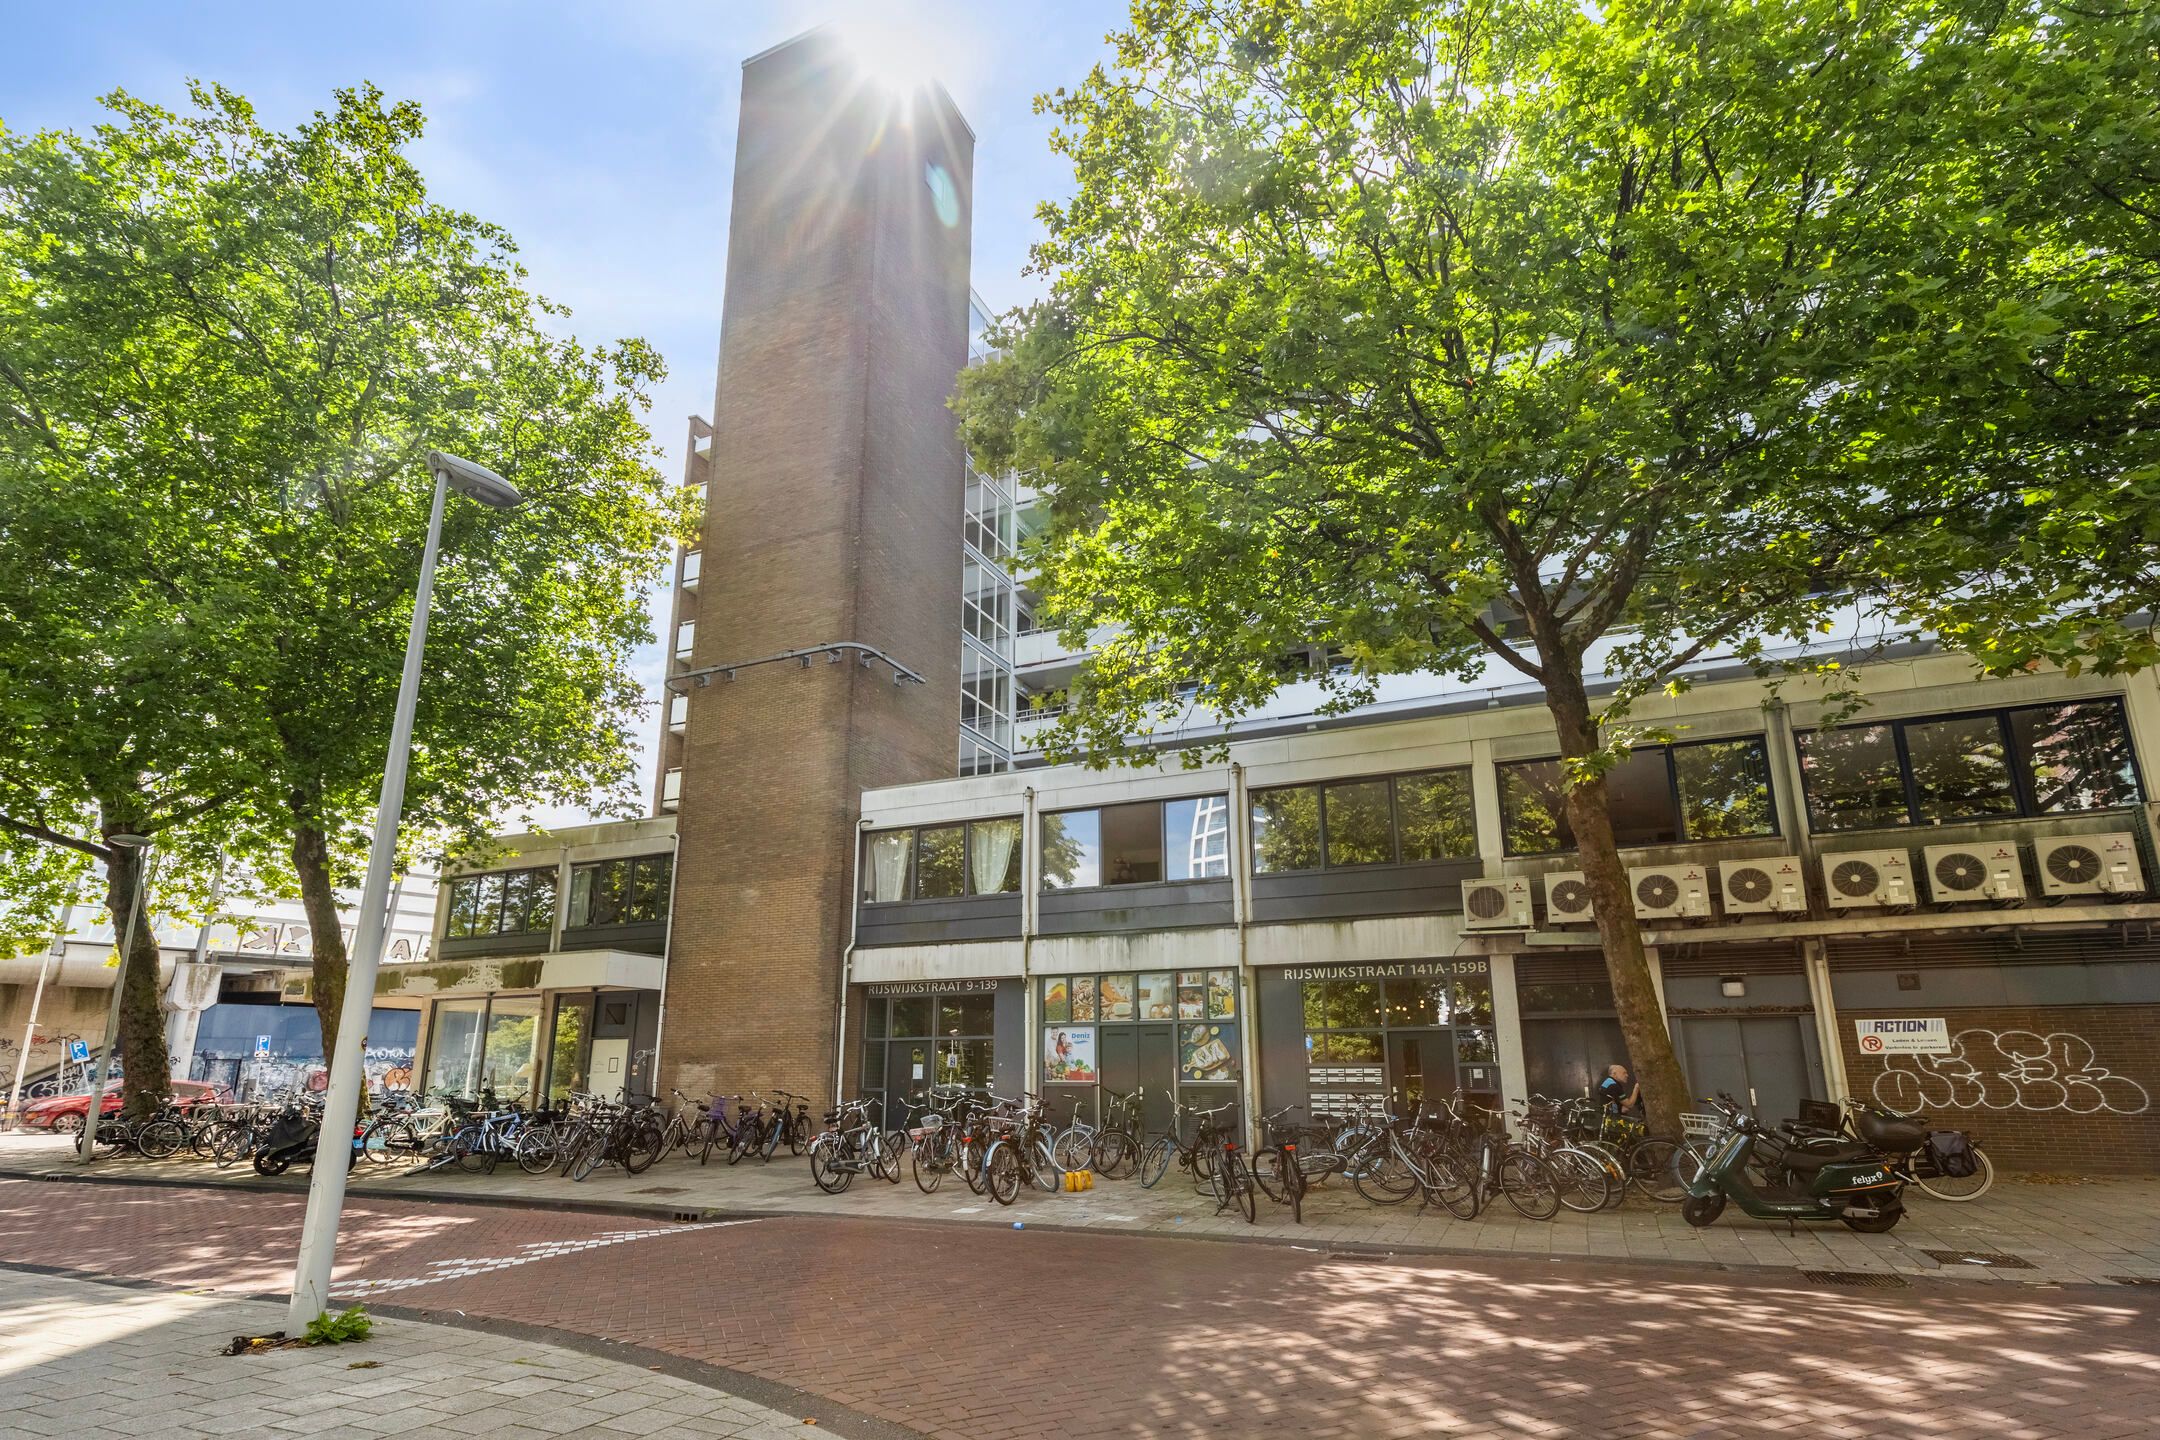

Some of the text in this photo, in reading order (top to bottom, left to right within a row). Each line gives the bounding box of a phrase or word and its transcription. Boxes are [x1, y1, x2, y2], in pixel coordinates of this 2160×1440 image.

[1284, 961, 1488, 980] RIJSWIJKSTRAAT 141A-159B
[868, 982, 961, 994] RIJSWIJKSTRAAT
[1874, 1020, 1926, 1032] ACTION
[73, 1043, 84, 1053] P
